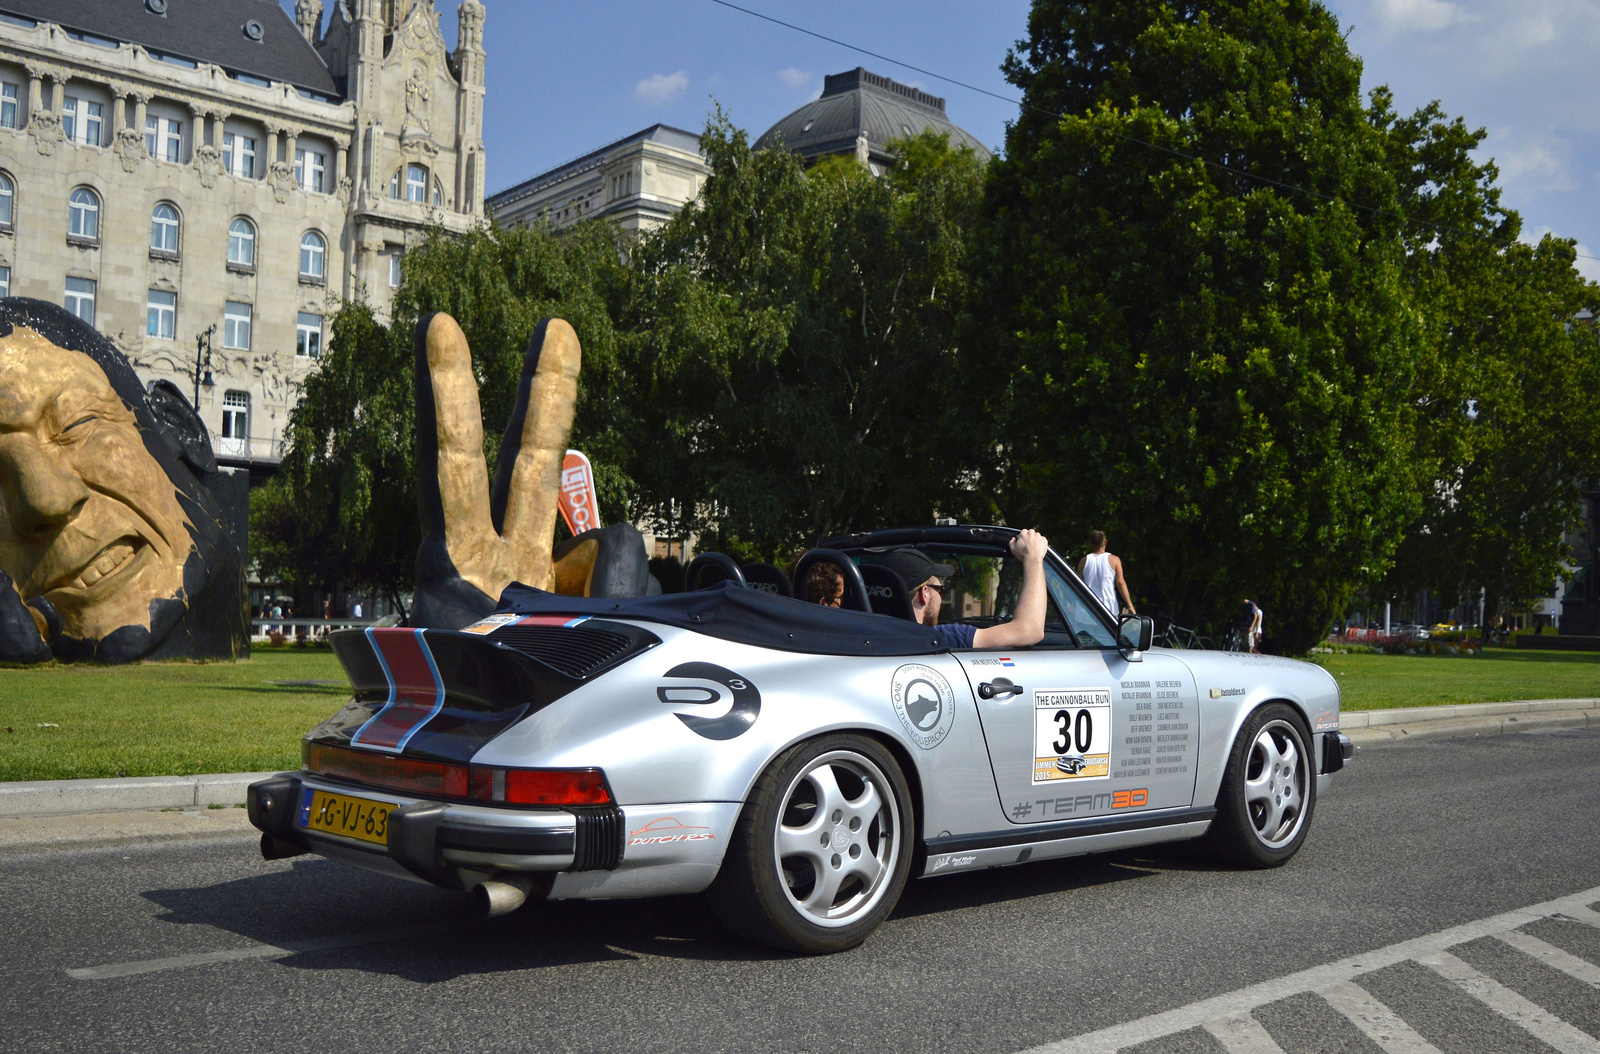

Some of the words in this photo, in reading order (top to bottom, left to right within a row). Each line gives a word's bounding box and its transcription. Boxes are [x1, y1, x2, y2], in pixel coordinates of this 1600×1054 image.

[1036, 695, 1049, 705] THE
[1051, 695, 1094, 705] CANNONBALL
[1095, 694, 1109, 704] RUN
[1053, 709, 1092, 754] 30
[1036, 761, 1056, 769] OMMEN
[1035, 771, 1050, 779] 2015
[1012, 788, 1148, 818] #TEAM30
[315, 797, 387, 837] JG-VJ-63
[631, 835, 683, 845] DUTCH
[685, 833, 711, 841] RS
